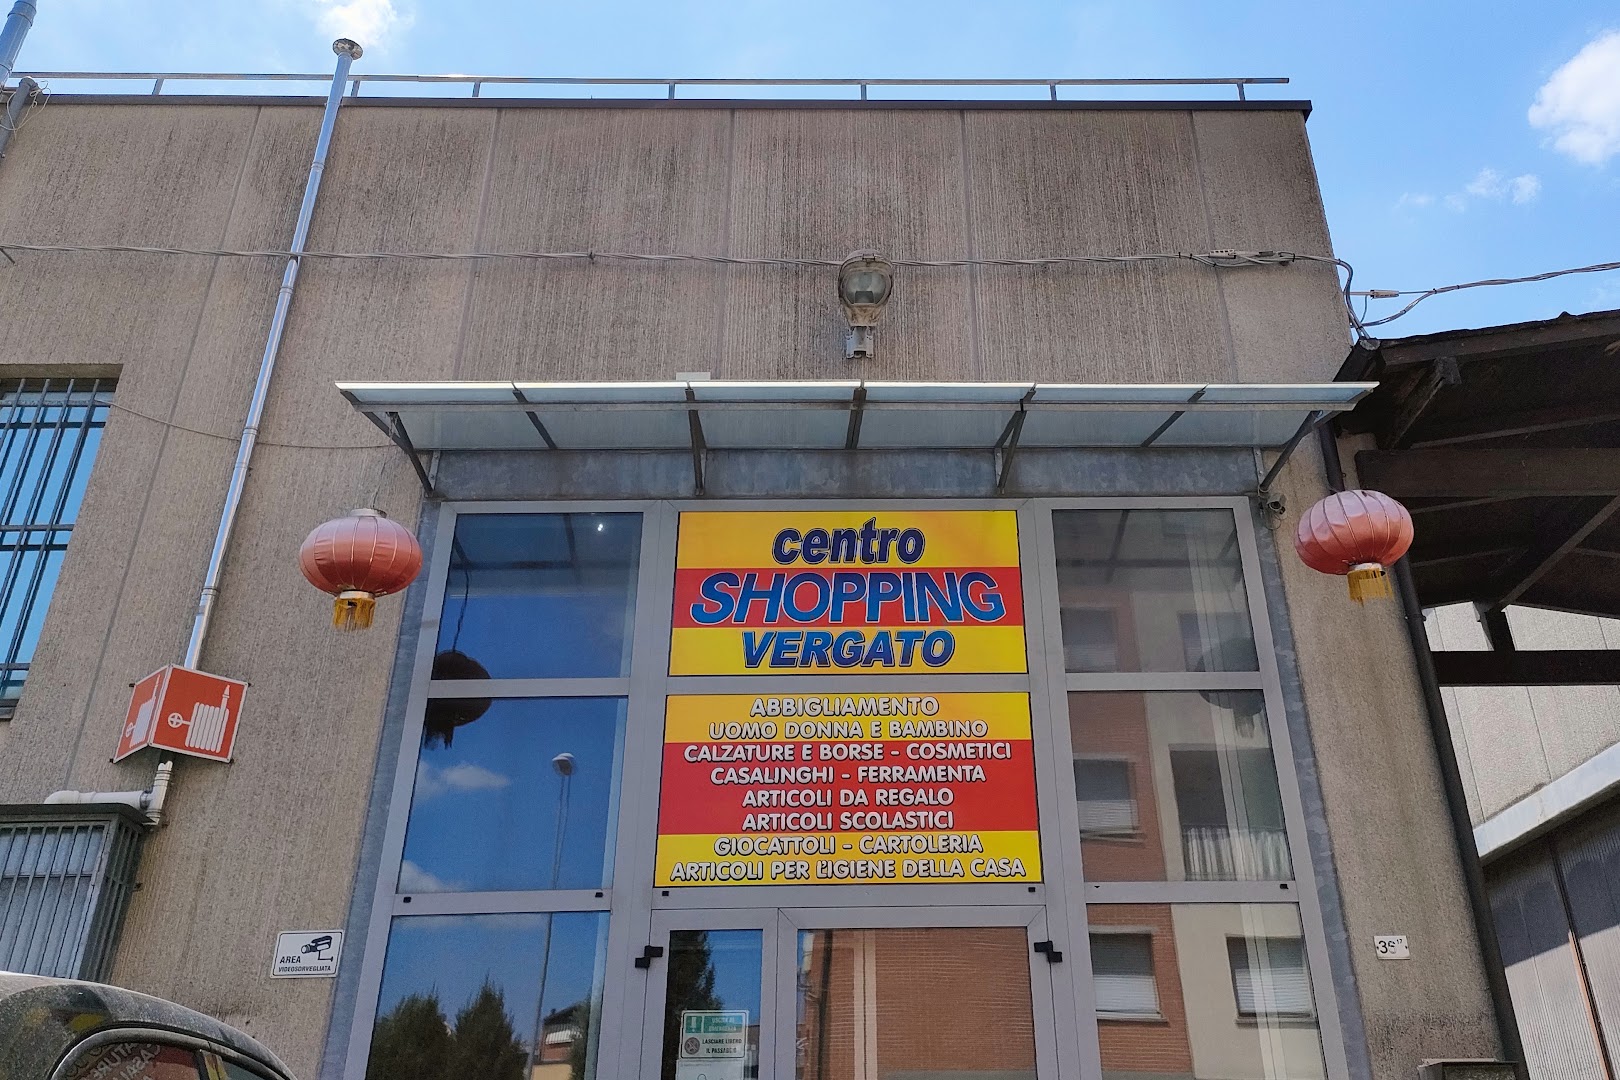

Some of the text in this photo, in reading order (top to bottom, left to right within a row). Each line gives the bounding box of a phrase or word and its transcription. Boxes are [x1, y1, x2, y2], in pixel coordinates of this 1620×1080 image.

[772, 517, 925, 564] centro
[690, 571, 1007, 624] SHOPPING
[741, 630, 955, 669] VERGATO
[750, 697, 939, 717] ABBIGLIAMENTO
[709, 719, 988, 741] UOMO DONNA E BAMBINO
[684, 745, 795, 763] CALZATURE
[801, 745, 813, 761] E
[819, 743, 884, 761] BORSE
[906, 742, 1012, 760] COSMETICI
[710, 766, 834, 786] CASALINGHI
[857, 765, 987, 784] FERRAMENTA
[742, 787, 955, 808] ARTICOLI DA REGALO
[741, 811, 954, 832] ARTICOLI SCOLASTICI
[713, 836, 835, 857] GIOCATTOLI
[859, 834, 984, 854] CARTOLERIA
[669, 858, 1026, 882] ARTICOLI PER L'IGIENE DELLA CASA
